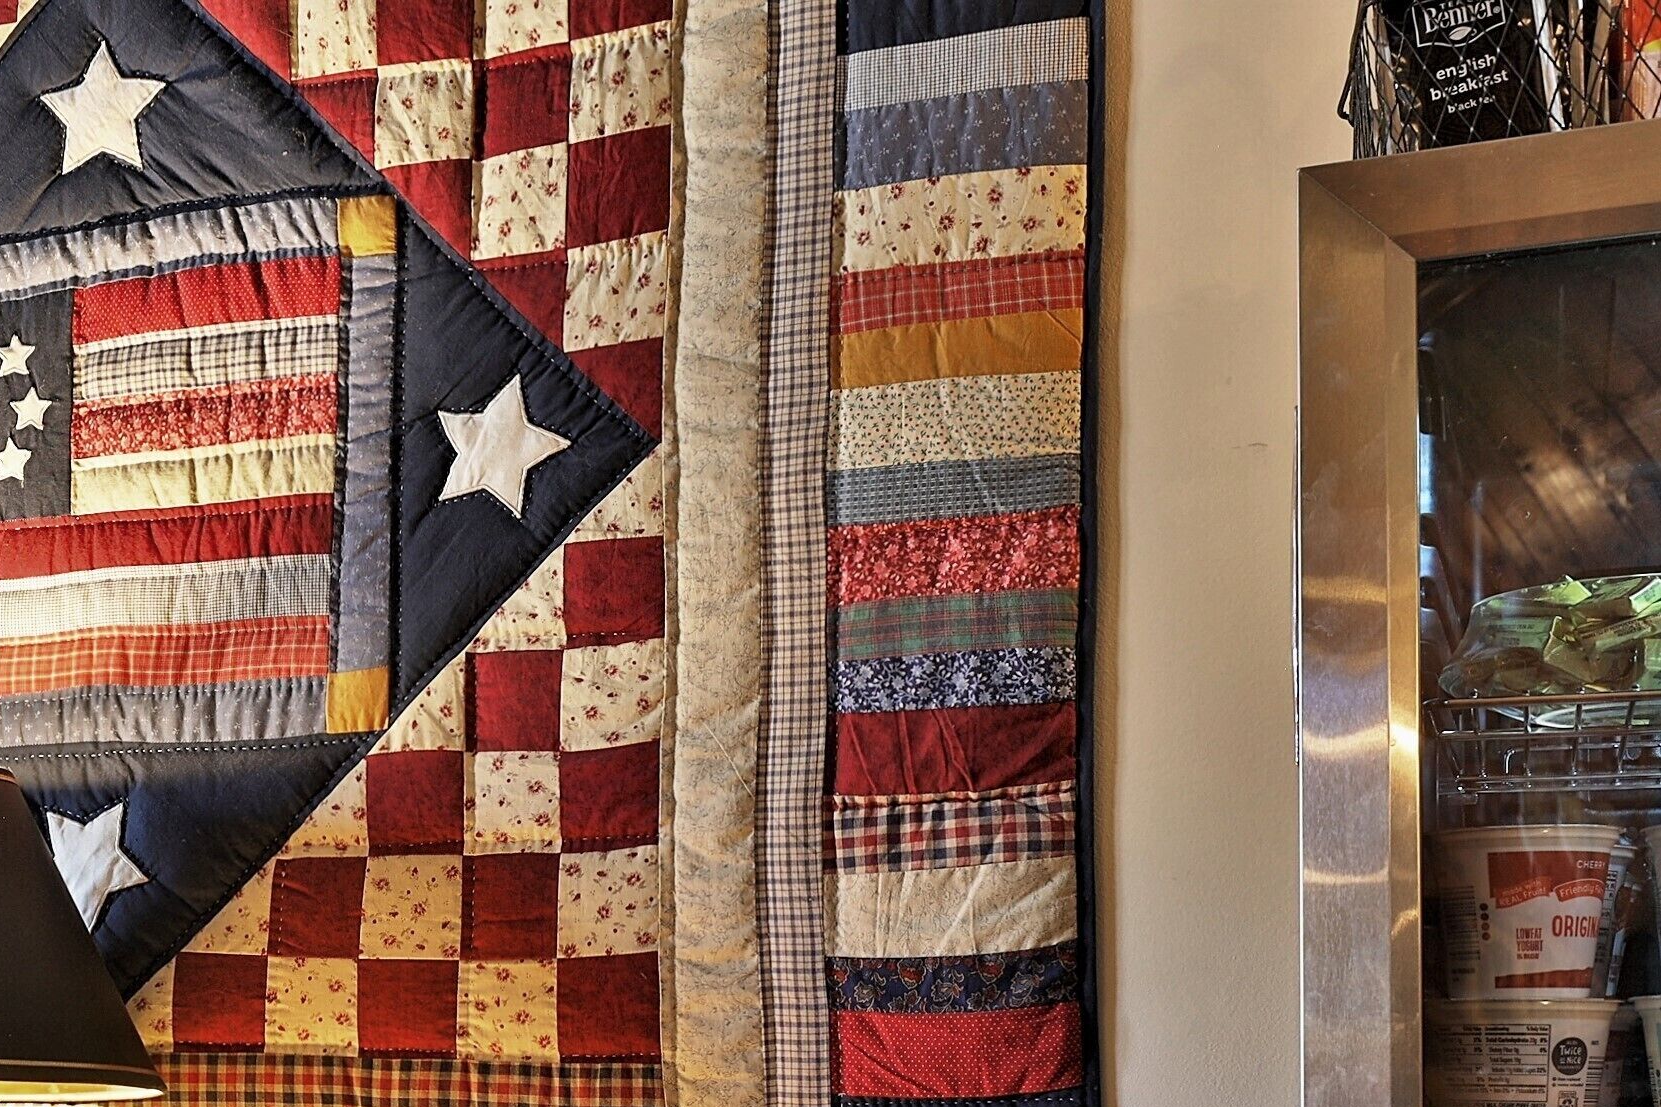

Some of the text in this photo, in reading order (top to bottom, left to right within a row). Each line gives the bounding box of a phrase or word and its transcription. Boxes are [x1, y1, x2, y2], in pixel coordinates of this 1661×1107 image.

[1436, 54, 1496, 80] english
[1430, 70, 1509, 101] breakfast
[1560, 884, 1595, 898] Friendly
